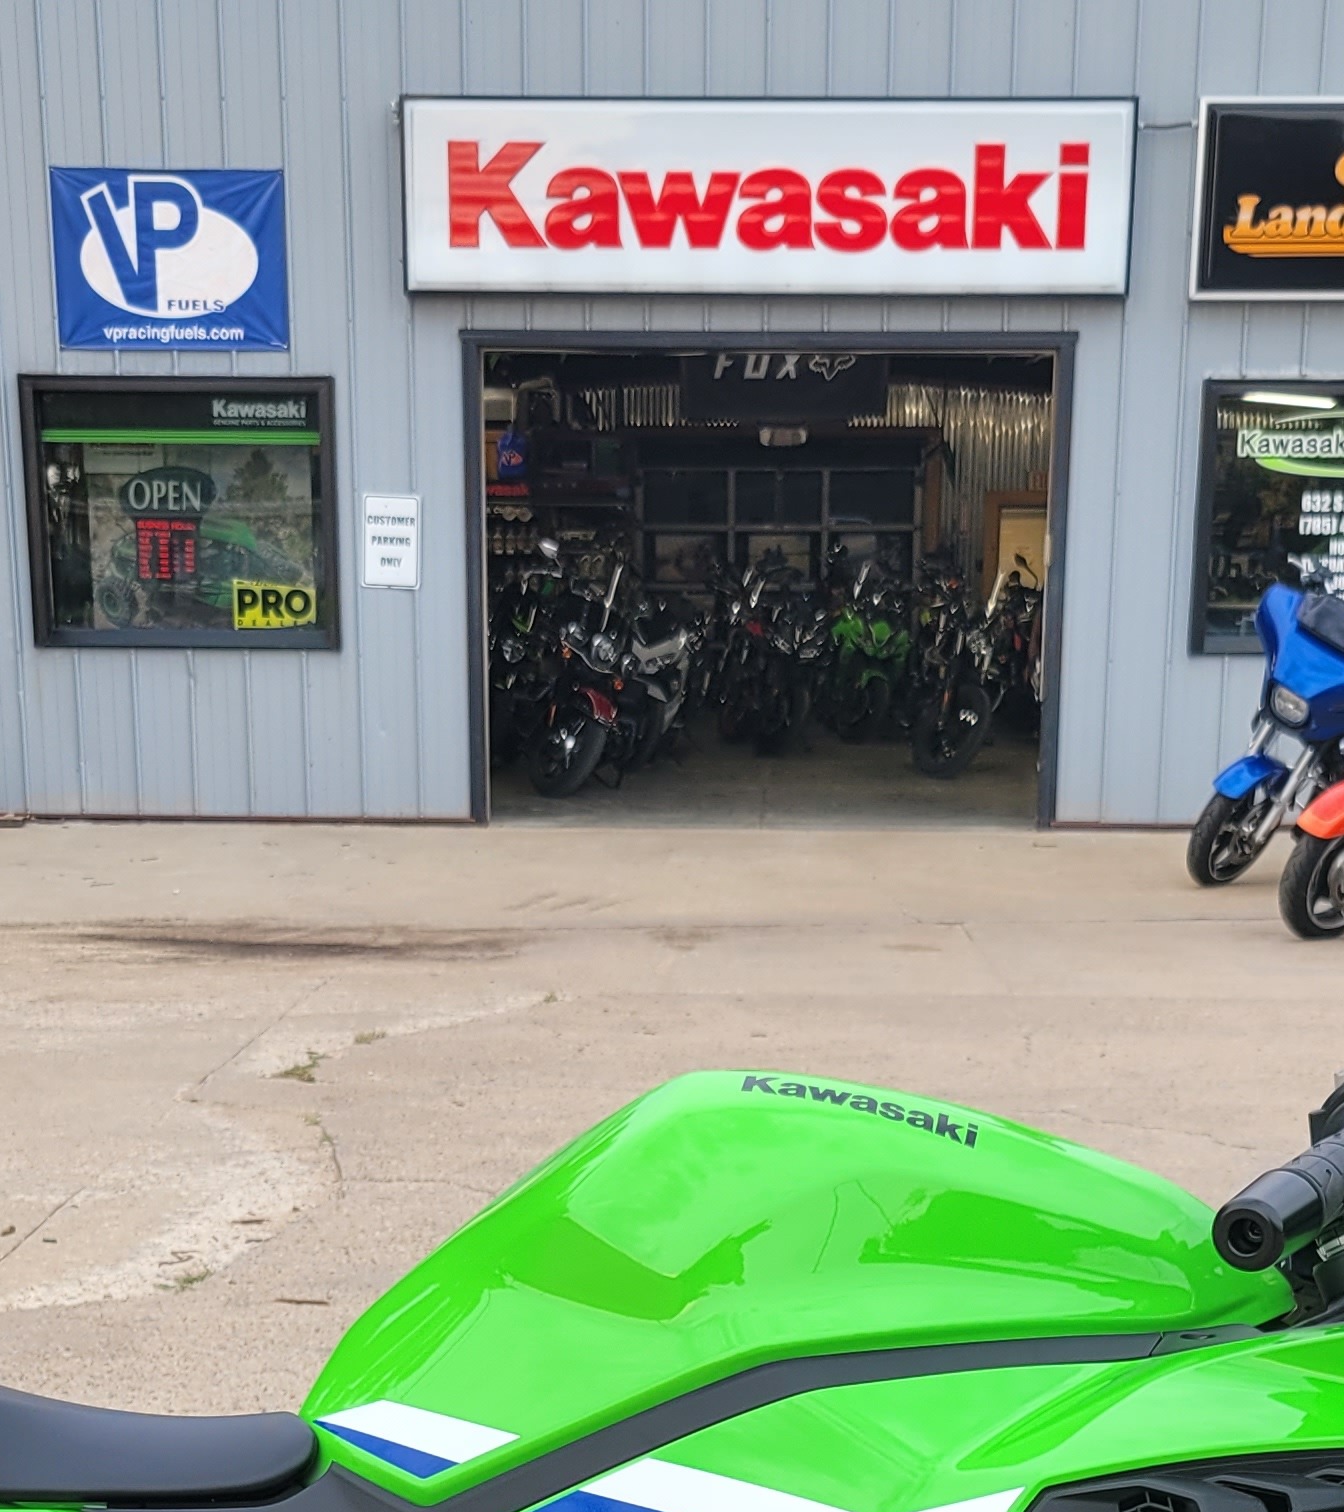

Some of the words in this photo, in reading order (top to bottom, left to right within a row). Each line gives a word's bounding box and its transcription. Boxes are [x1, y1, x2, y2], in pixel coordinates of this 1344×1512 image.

[446, 139, 1091, 254] Kawasaki
[81, 176, 202, 314] VP
[167, 299, 225, 312] FUELS
[102, 323, 244, 343] vpracingfuels.com
[212, 399, 306, 418] Kawasaki
[128, 479, 202, 512] OPEN
[1301, 490, 1332, 513] 632
[367, 515, 416, 527] CUSTOMER
[1298, 514, 1338, 536] (785)
[371, 535, 411, 546] PARKING
[380, 557, 402, 567] ONLY
[237, 589, 312, 620] PRO
[741, 1075, 979, 1149] Kawasaki
